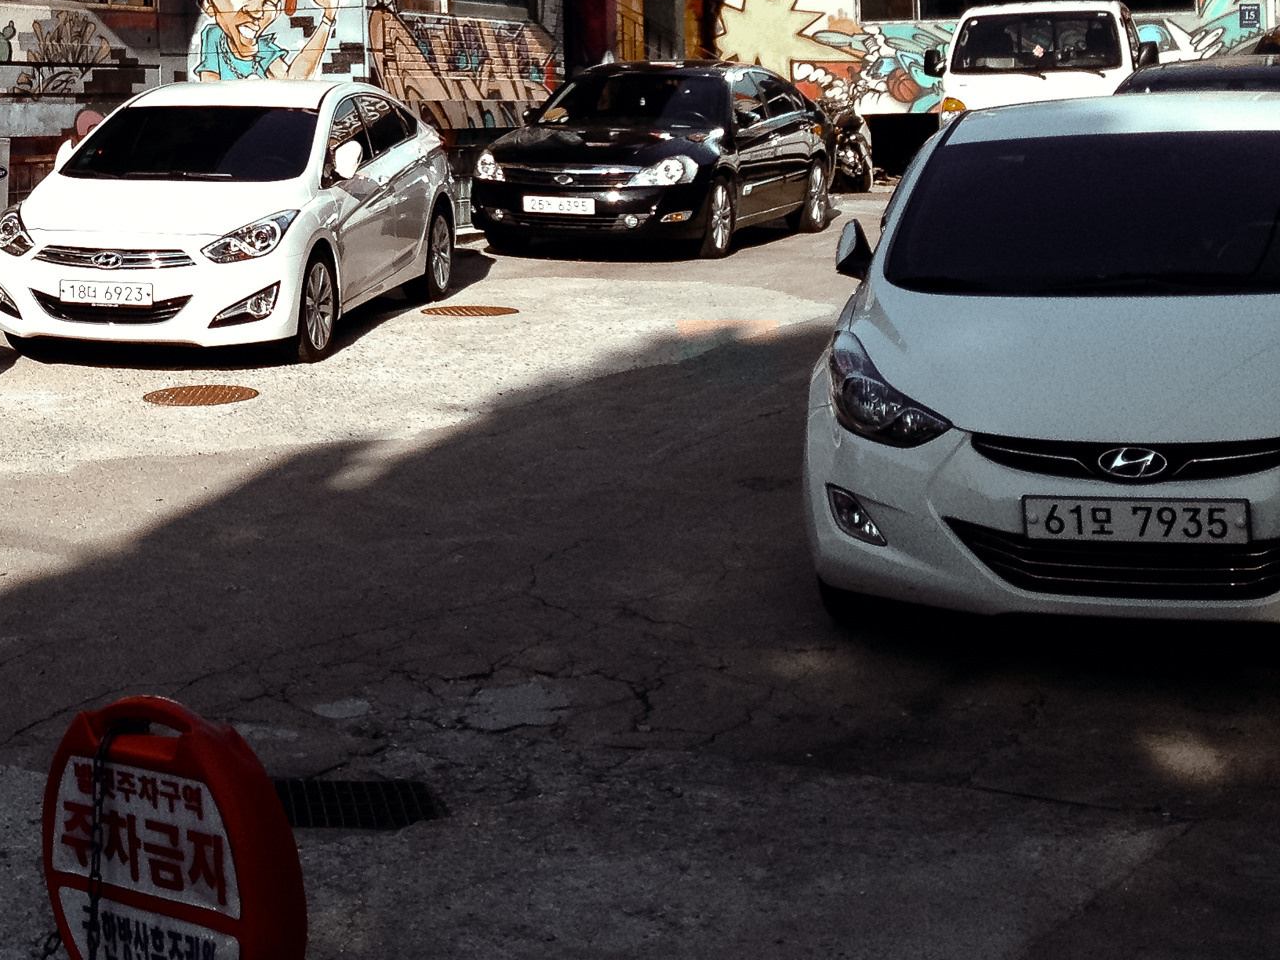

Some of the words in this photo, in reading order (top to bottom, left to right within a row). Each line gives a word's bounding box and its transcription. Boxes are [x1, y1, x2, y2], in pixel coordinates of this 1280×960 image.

[1245, 10, 1256, 20] 15
[104, 285, 143, 302] 6923
[1044, 504, 1114, 536] 61모
[1131, 506, 1228, 539] 7935
[61, 801, 227, 906] 주차금지
